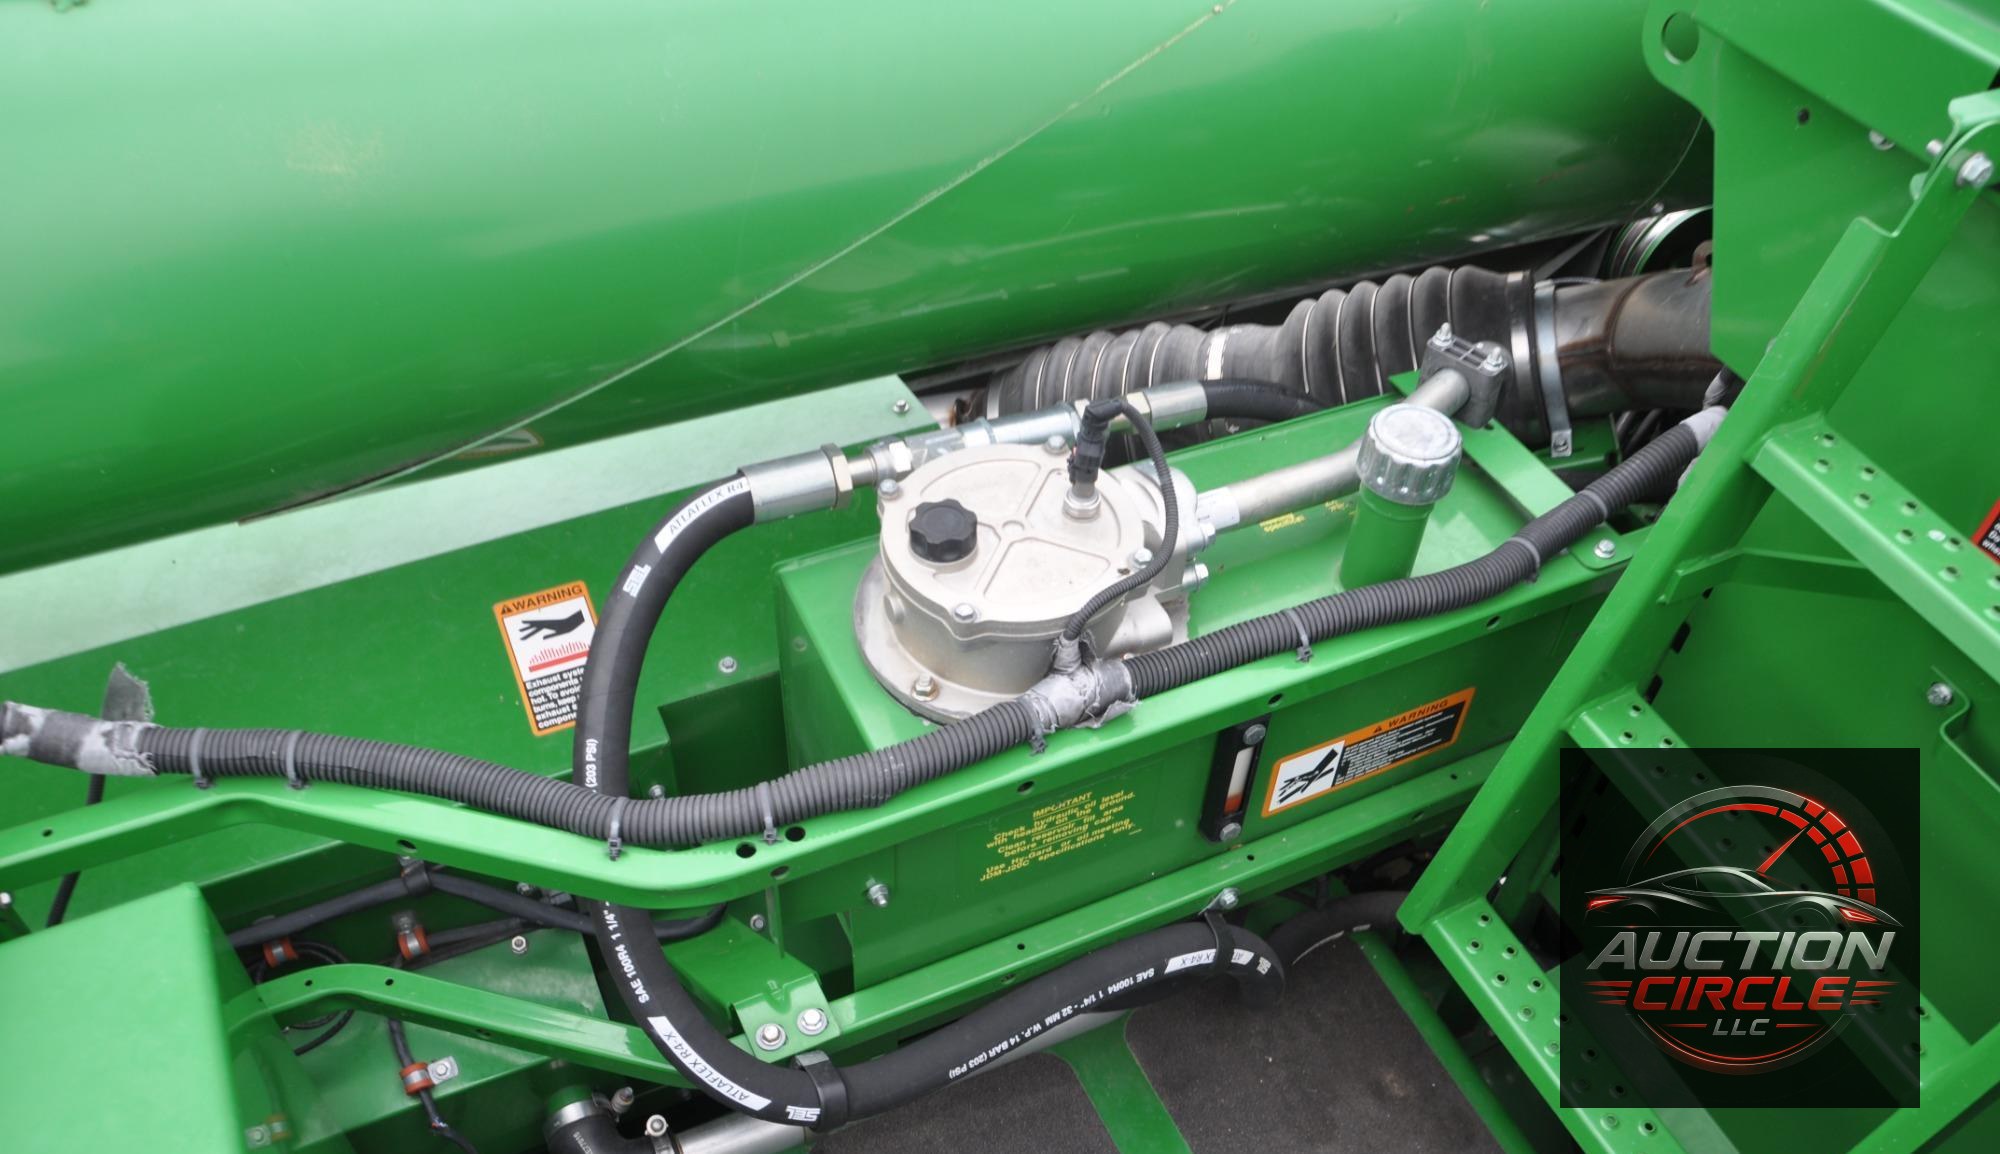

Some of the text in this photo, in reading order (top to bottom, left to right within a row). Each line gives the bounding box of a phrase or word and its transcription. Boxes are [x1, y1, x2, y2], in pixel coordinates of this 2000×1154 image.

[513, 584, 583, 613] WARNING
[526, 673, 561, 690] Exhaust
[528, 677, 580, 698] components
[547, 691, 559, 701] To
[536, 704, 571, 721] exhaust
[1388, 699, 1449, 728] WARNING
[585, 738, 600, 788] (203 PSI)
[1033, 791, 1092, 818] IMPORTANT
[986, 837, 1008, 849] with
[1055, 816, 1068, 825] on
[1077, 807, 1092, 817] the
[1099, 791, 1136, 811] ground.
[994, 790, 1124, 840] Check hydraulic oil level
[997, 804, 1124, 854] Clean reservoir fill area
[986, 818, 1131, 874] Use Hy-Gard or oil meeting
[1004, 842, 1037, 858] before
[1042, 823, 1089, 844] removing
[980, 859, 1031, 882] JDM-J20C
[1038, 831, 1105, 862] specifications
[610, 932, 622, 941] 1
[614, 944, 637, 979] 100R4
[1135, 968, 1155, 983] SAE
[630, 978, 651, 1004] SAE
[1107, 976, 1135, 994] 100R4
[1098, 990, 1105, 999] 1
[1044, 1011, 1061, 1026] MM
[1061, 1005, 1073, 1018] 32
[1021, 1022, 1042, 1038] W.P.
[988, 1040, 1009, 1058] BAR
[1009, 1034, 1021, 1046] 14
[663, 1031, 751, 1101] ATLAFLEX R4-X
[968, 1051, 988, 1069] (203
[948, 1063, 968, 1080] PSI)
[785, 1105, 821, 1122] SEL
